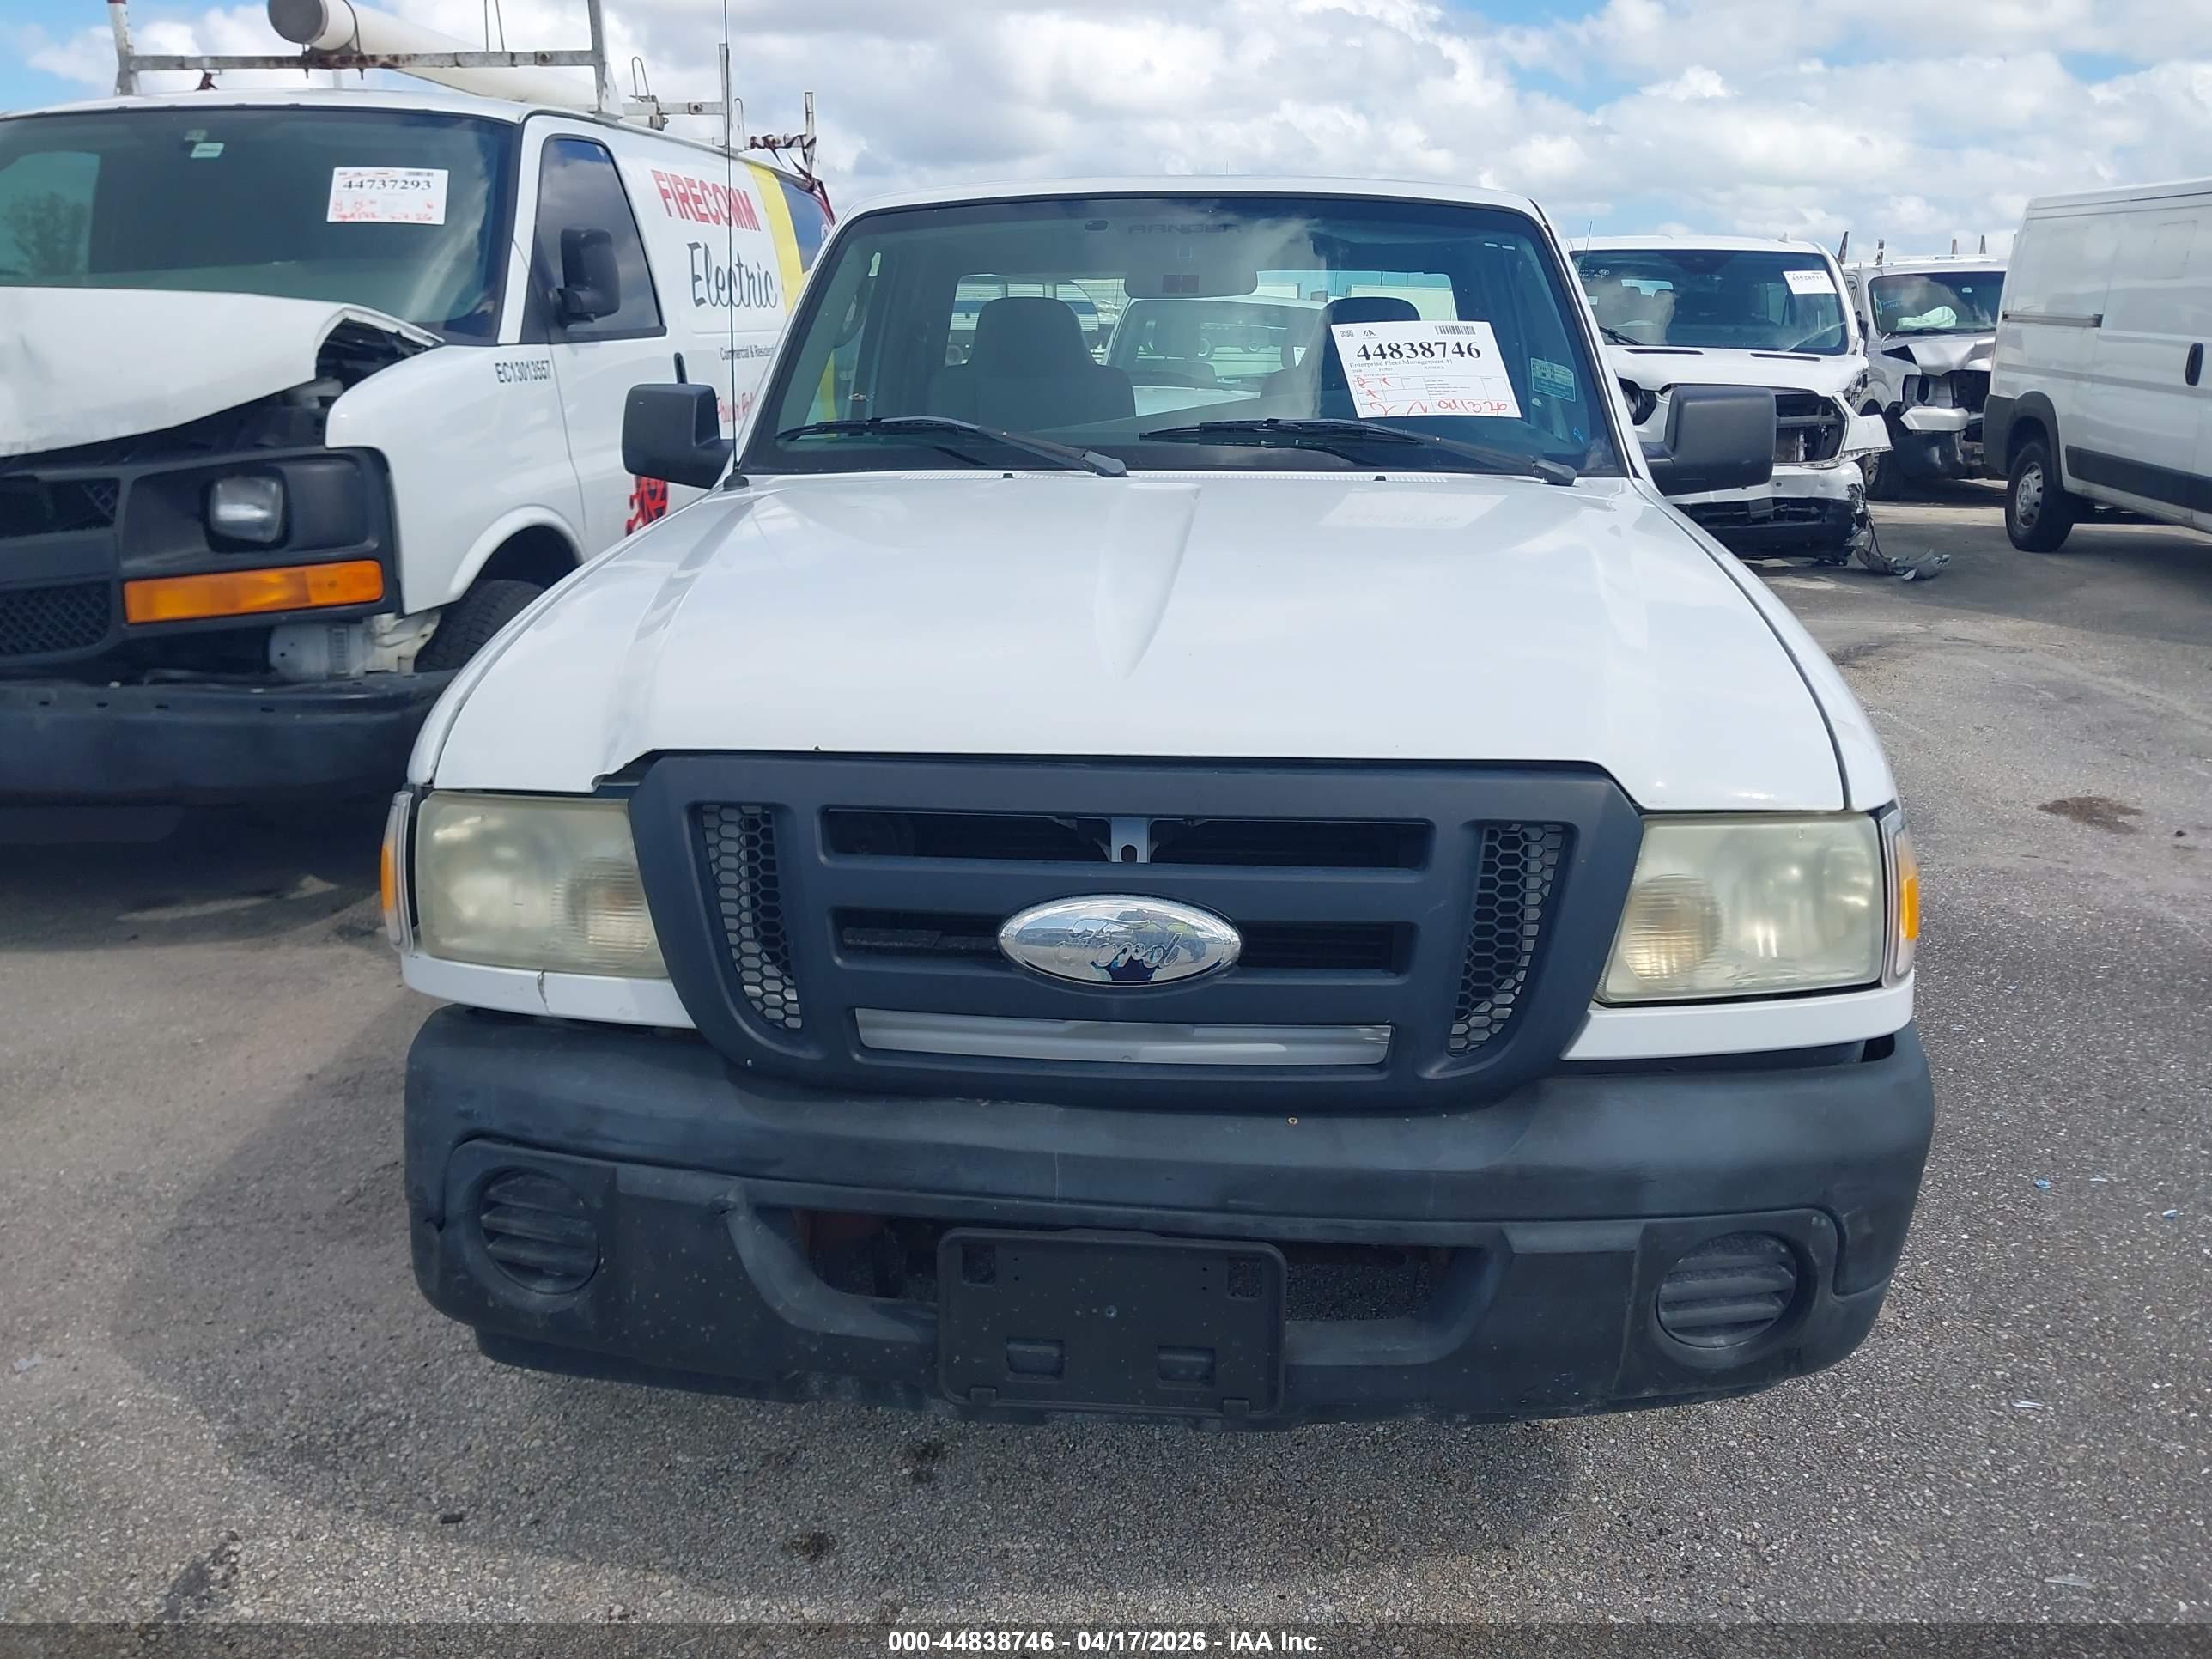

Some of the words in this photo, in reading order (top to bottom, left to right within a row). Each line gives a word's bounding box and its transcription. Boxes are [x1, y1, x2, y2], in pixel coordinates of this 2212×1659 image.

[343, 179, 432, 190] 44737293
[651, 169, 762, 232] FIRECOMM
[1127, 223, 1243, 234] RANGER
[686, 241, 778, 310] Electric
[1357, 341, 1481, 361] 44838746
[1349, 361, 1383, 369] Enterprise
[1402, 358, 1445, 367] Management
[1055, 917, 1182, 969] Ford
